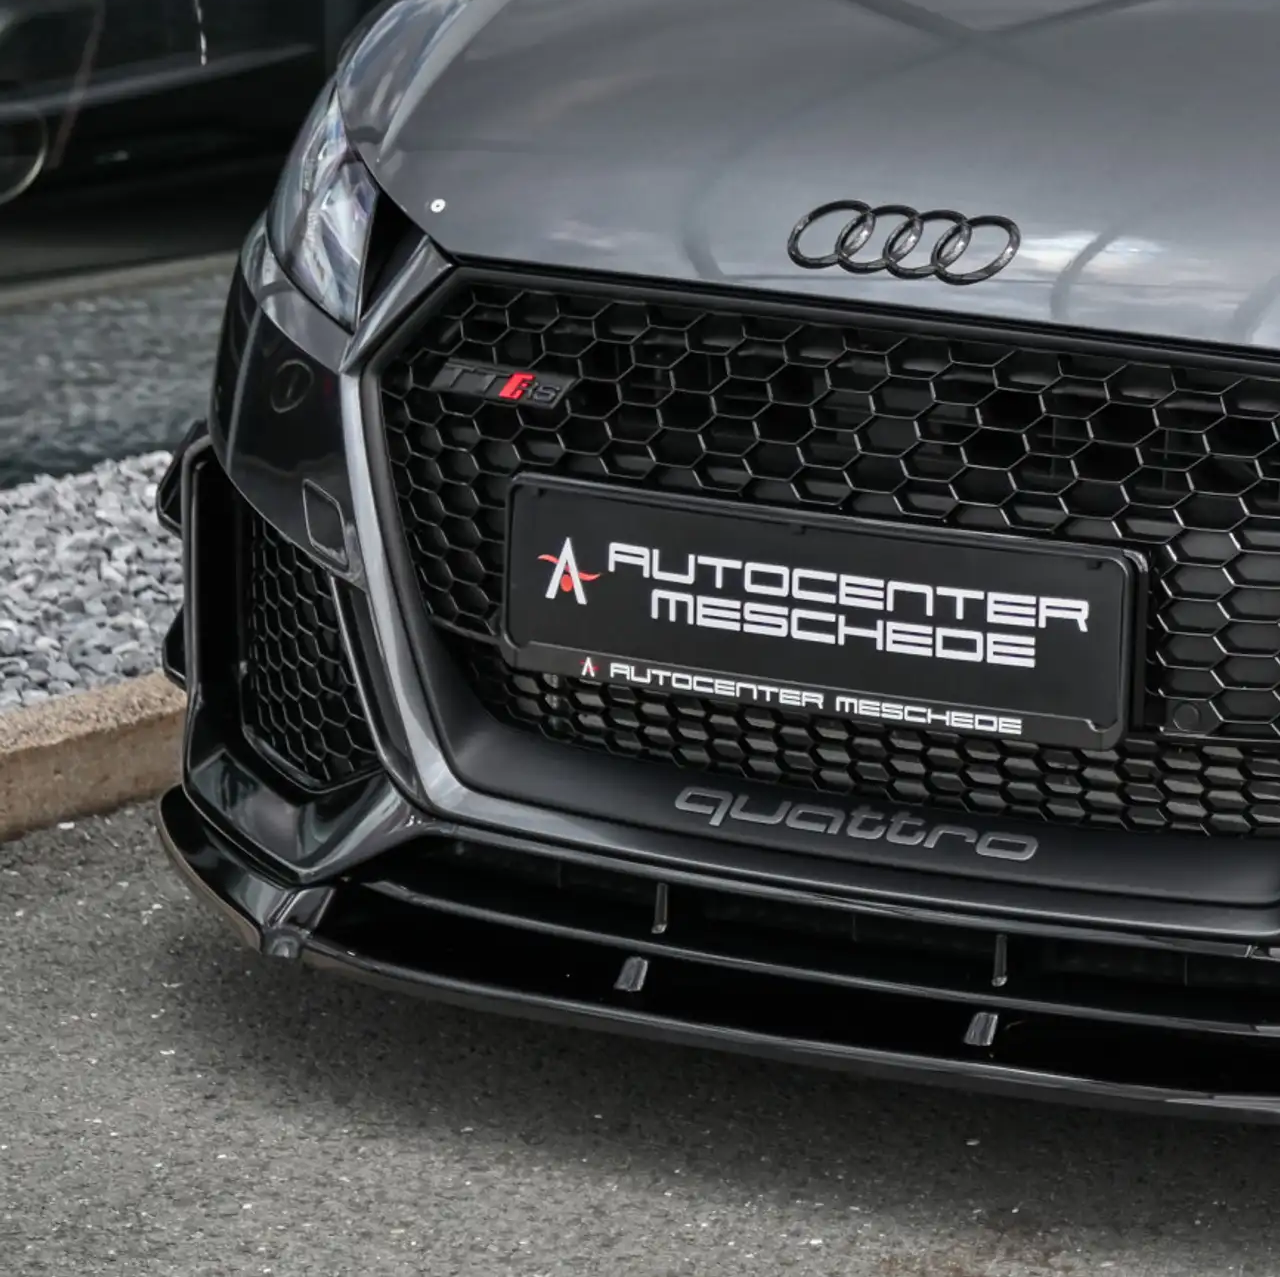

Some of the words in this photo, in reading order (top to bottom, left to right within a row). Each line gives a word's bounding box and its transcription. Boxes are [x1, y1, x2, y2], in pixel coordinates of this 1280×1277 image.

[607, 541, 1090, 632] AUTOCENTER
[650, 588, 1036, 668] MESCHEDE
[609, 662, 824, 710] AUTOCENTER
[834, 696, 1022, 735] MESCHEDE
[675, 786, 1039, 862] quattro
